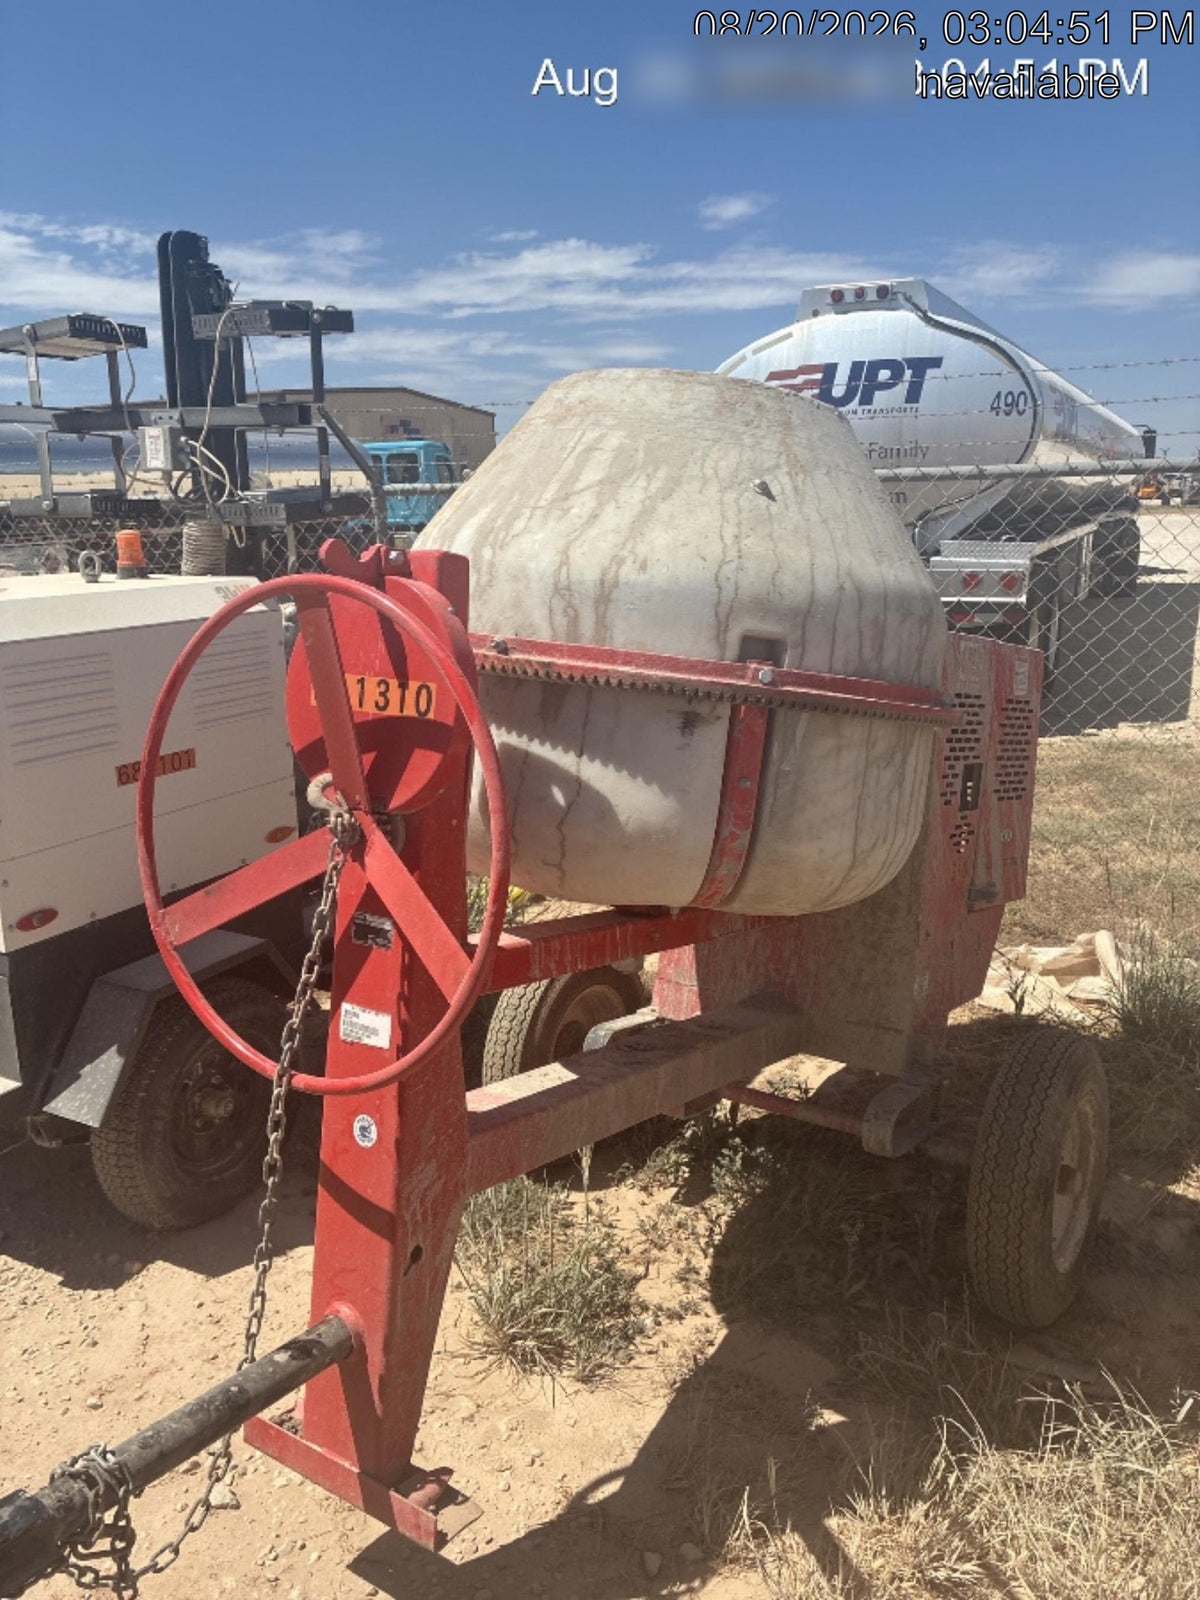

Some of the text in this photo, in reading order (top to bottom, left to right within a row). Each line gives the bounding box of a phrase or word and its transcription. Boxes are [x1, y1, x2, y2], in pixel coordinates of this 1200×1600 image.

[817, 356, 944, 408] UPT
[990, 390, 1027, 417] 490
[868, 440, 930, 460] Family
[355, 675, 433, 718] 1310
[118, 747, 192, 786] 68101
